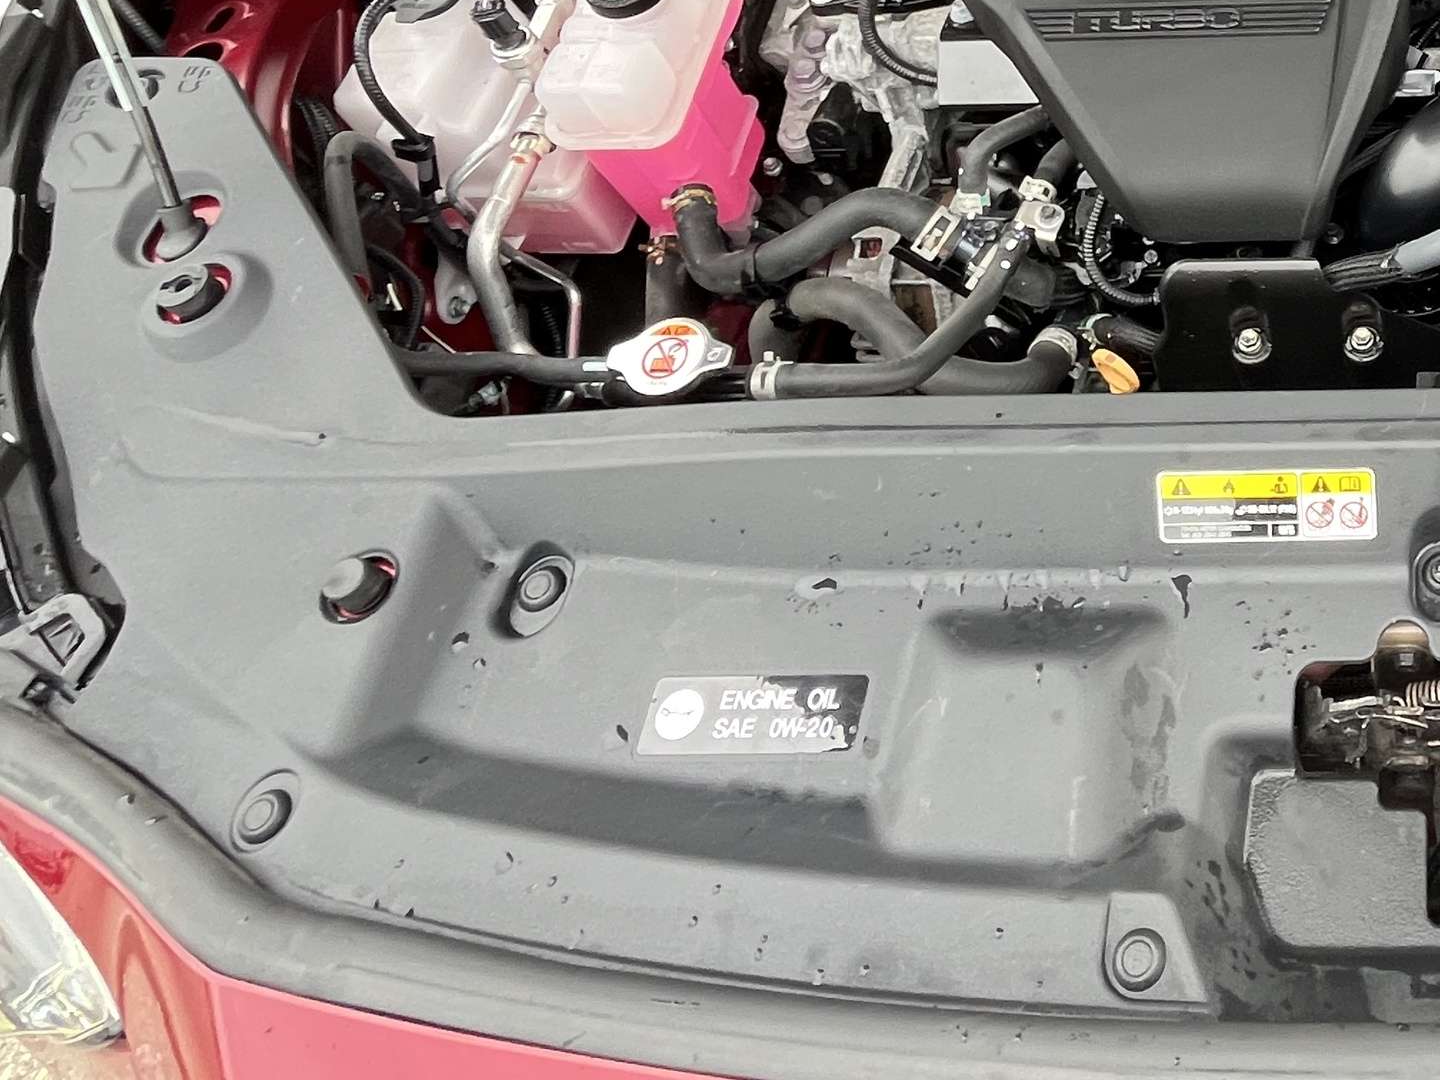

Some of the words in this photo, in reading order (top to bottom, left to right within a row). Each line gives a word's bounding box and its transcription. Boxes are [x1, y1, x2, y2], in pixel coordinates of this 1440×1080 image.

[1077, 7, 1241, 33] TURBO
[719, 689, 797, 711] ENGINE
[807, 688, 841, 710] OIL
[712, 718, 757, 739] SAE
[768, 717, 834, 738] 0W-20
